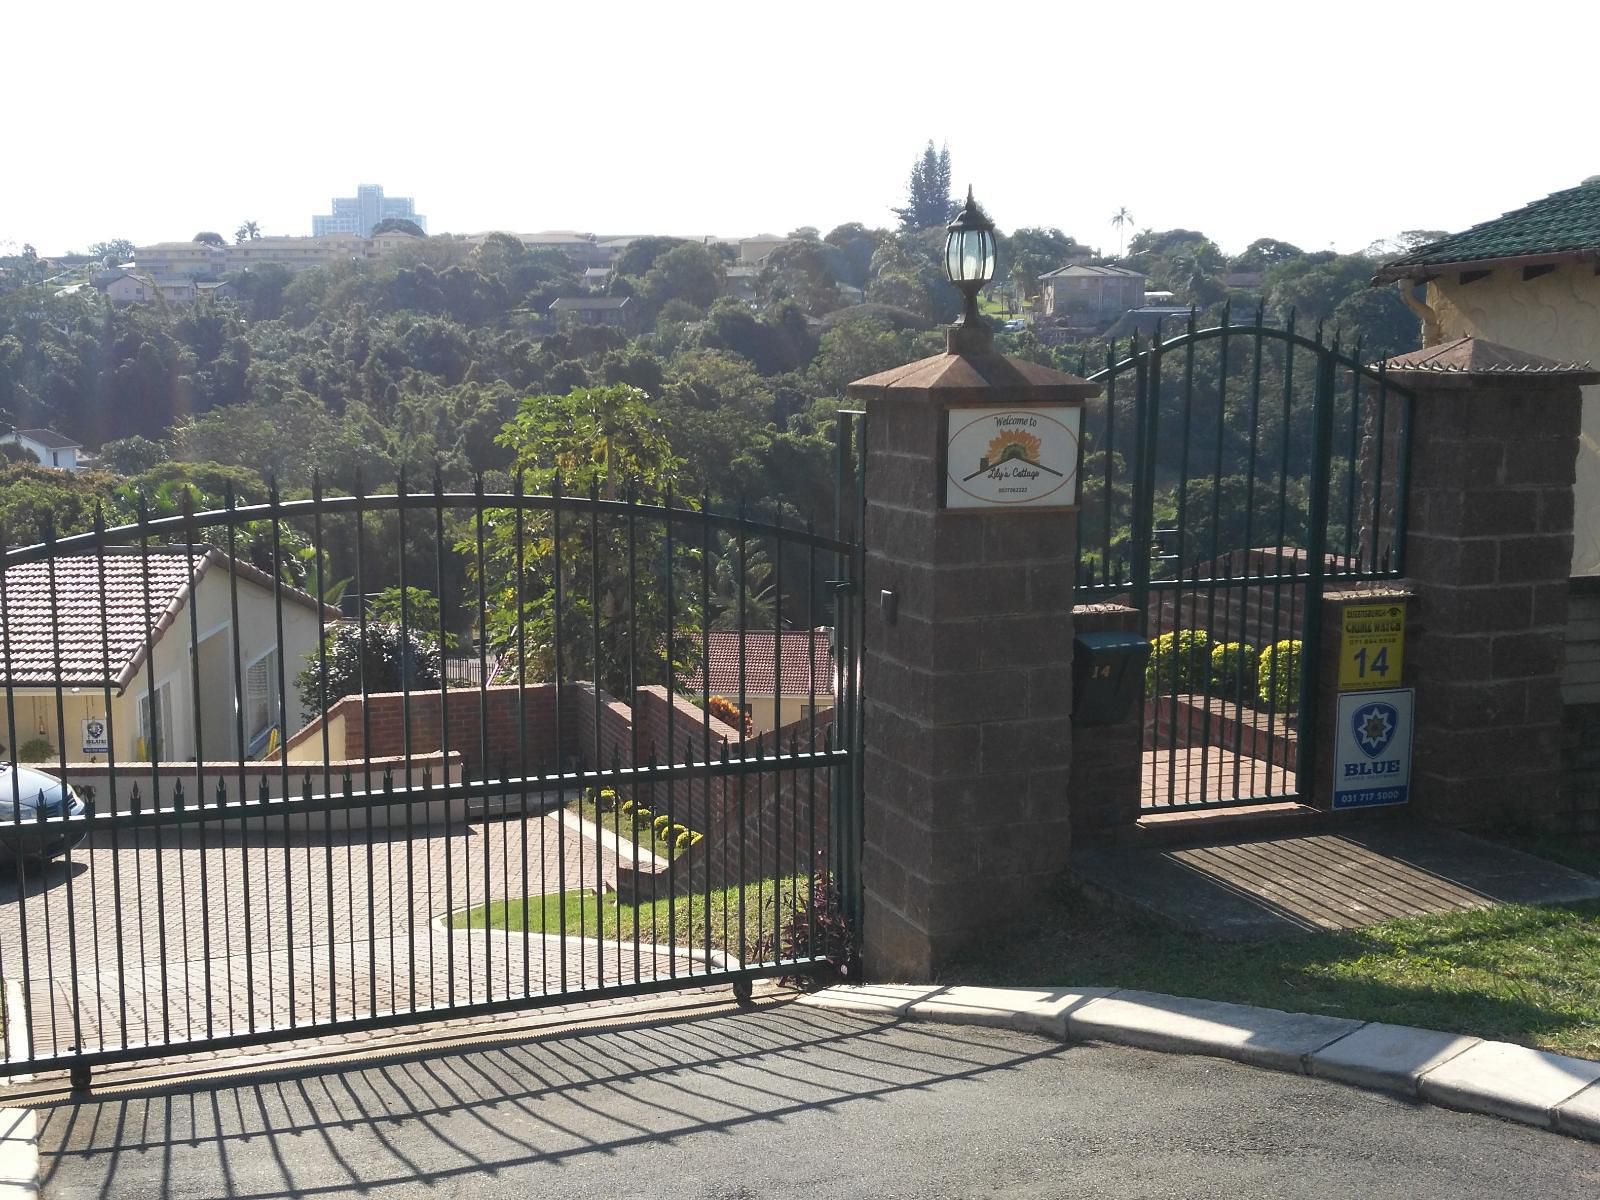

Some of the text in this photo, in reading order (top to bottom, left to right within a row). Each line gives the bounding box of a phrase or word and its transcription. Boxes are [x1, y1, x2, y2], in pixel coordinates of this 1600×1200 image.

[994, 415, 1037, 427] Welcome to
[988, 467, 1040, 480] Lily's Cottage
[1345, 622, 1401, 634] CRIME WATCH
[1353, 647, 1389, 678] 14
[1091, 665, 1111, 678] 14
[1344, 760, 1400, 776] BLUE
[1341, 790, 1400, 803] 031 717 5000
